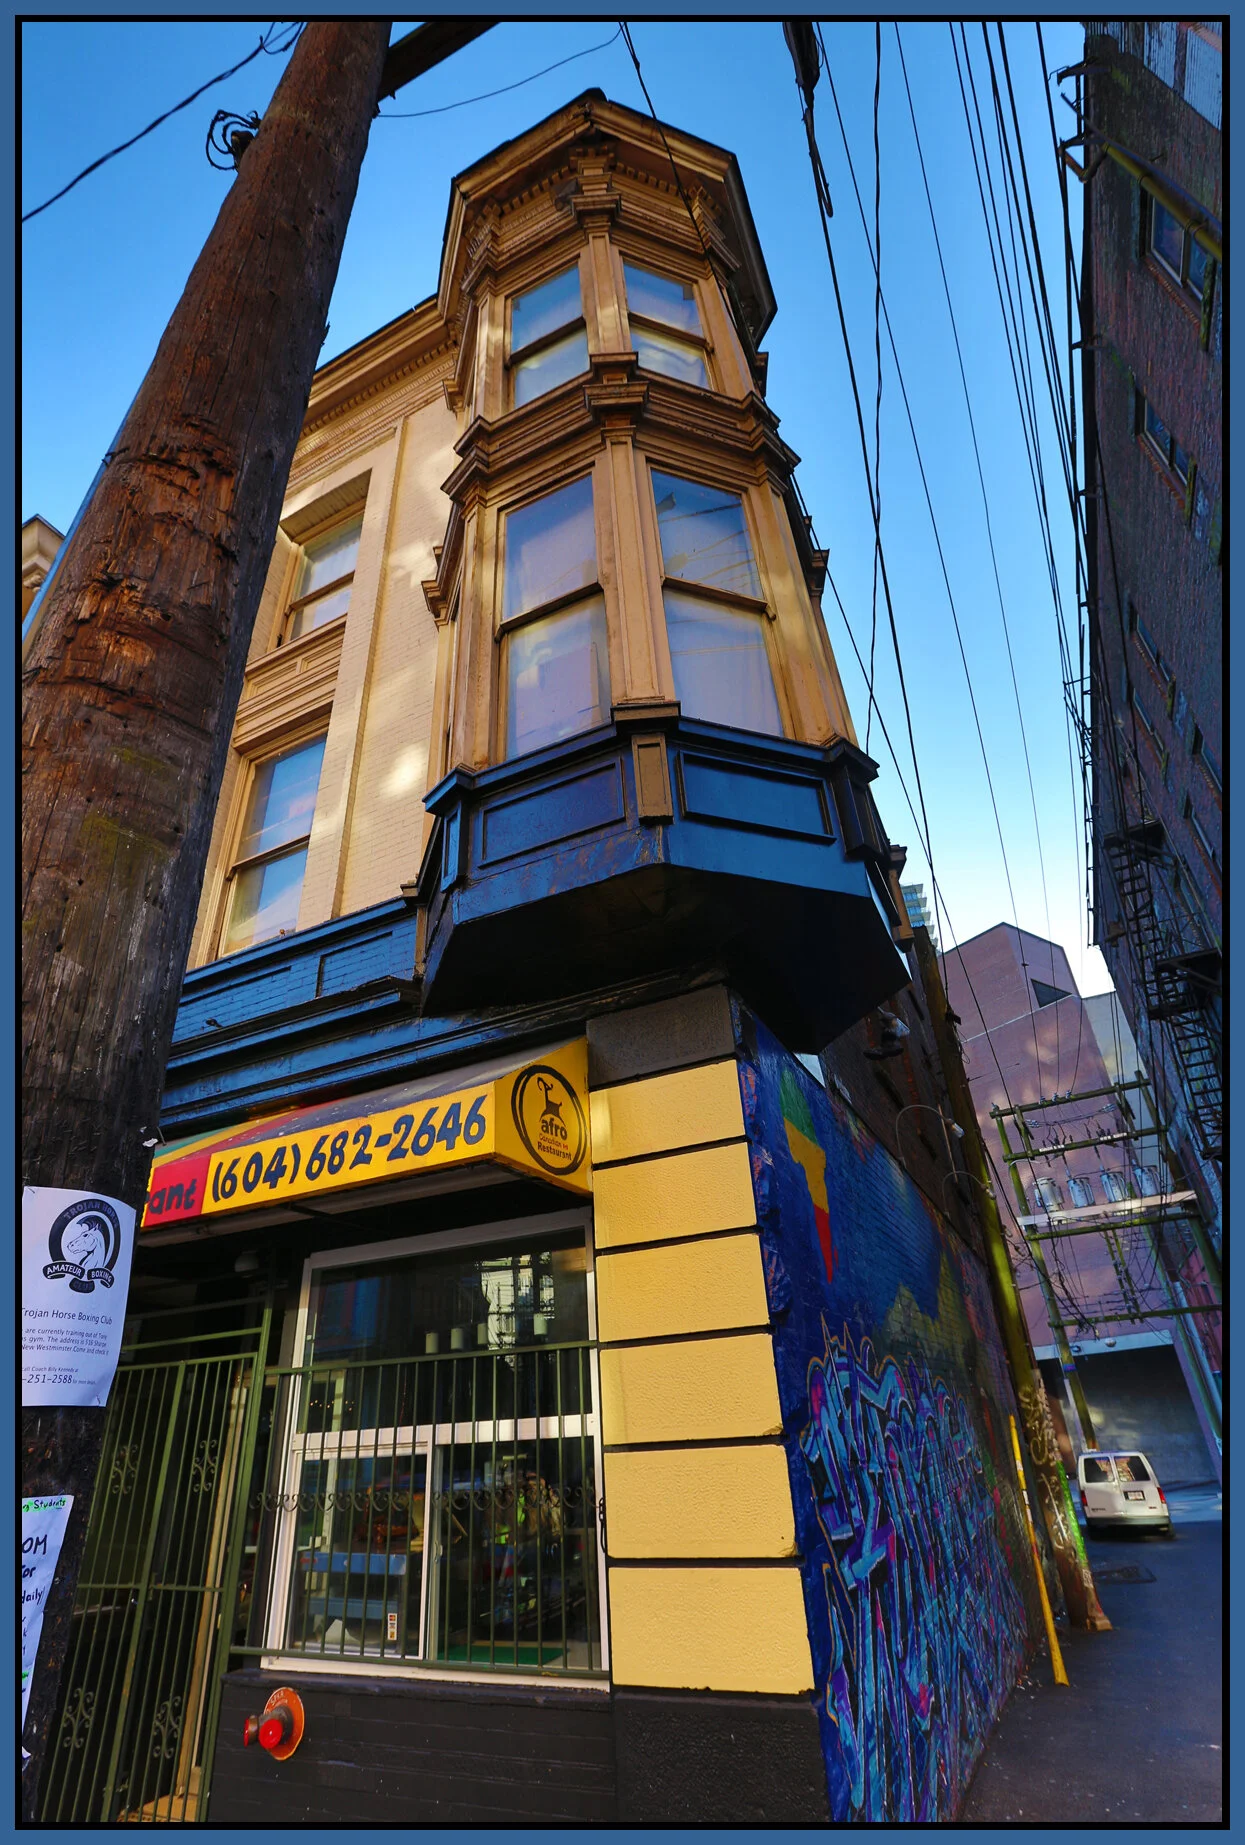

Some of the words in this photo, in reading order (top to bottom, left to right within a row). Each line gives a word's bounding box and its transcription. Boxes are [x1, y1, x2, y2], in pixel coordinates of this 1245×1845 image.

[541, 1118, 567, 1140] afro
[537, 1141, 572, 1161] Restaurant
[146, 1178, 197, 1215] ant
[63, 1202, 101, 1220] TROJAN
[46, 1264, 82, 1278] AMATEUR
[91, 1270, 112, 1283] BOXING
[51, 1310, 76, 1320] Horse
[78, 1312, 99, 1325] Boxing
[100, 1315, 113, 1325] Club
[37, 1328, 64, 1336] currently
[33, 1498, 66, 1510] Students
